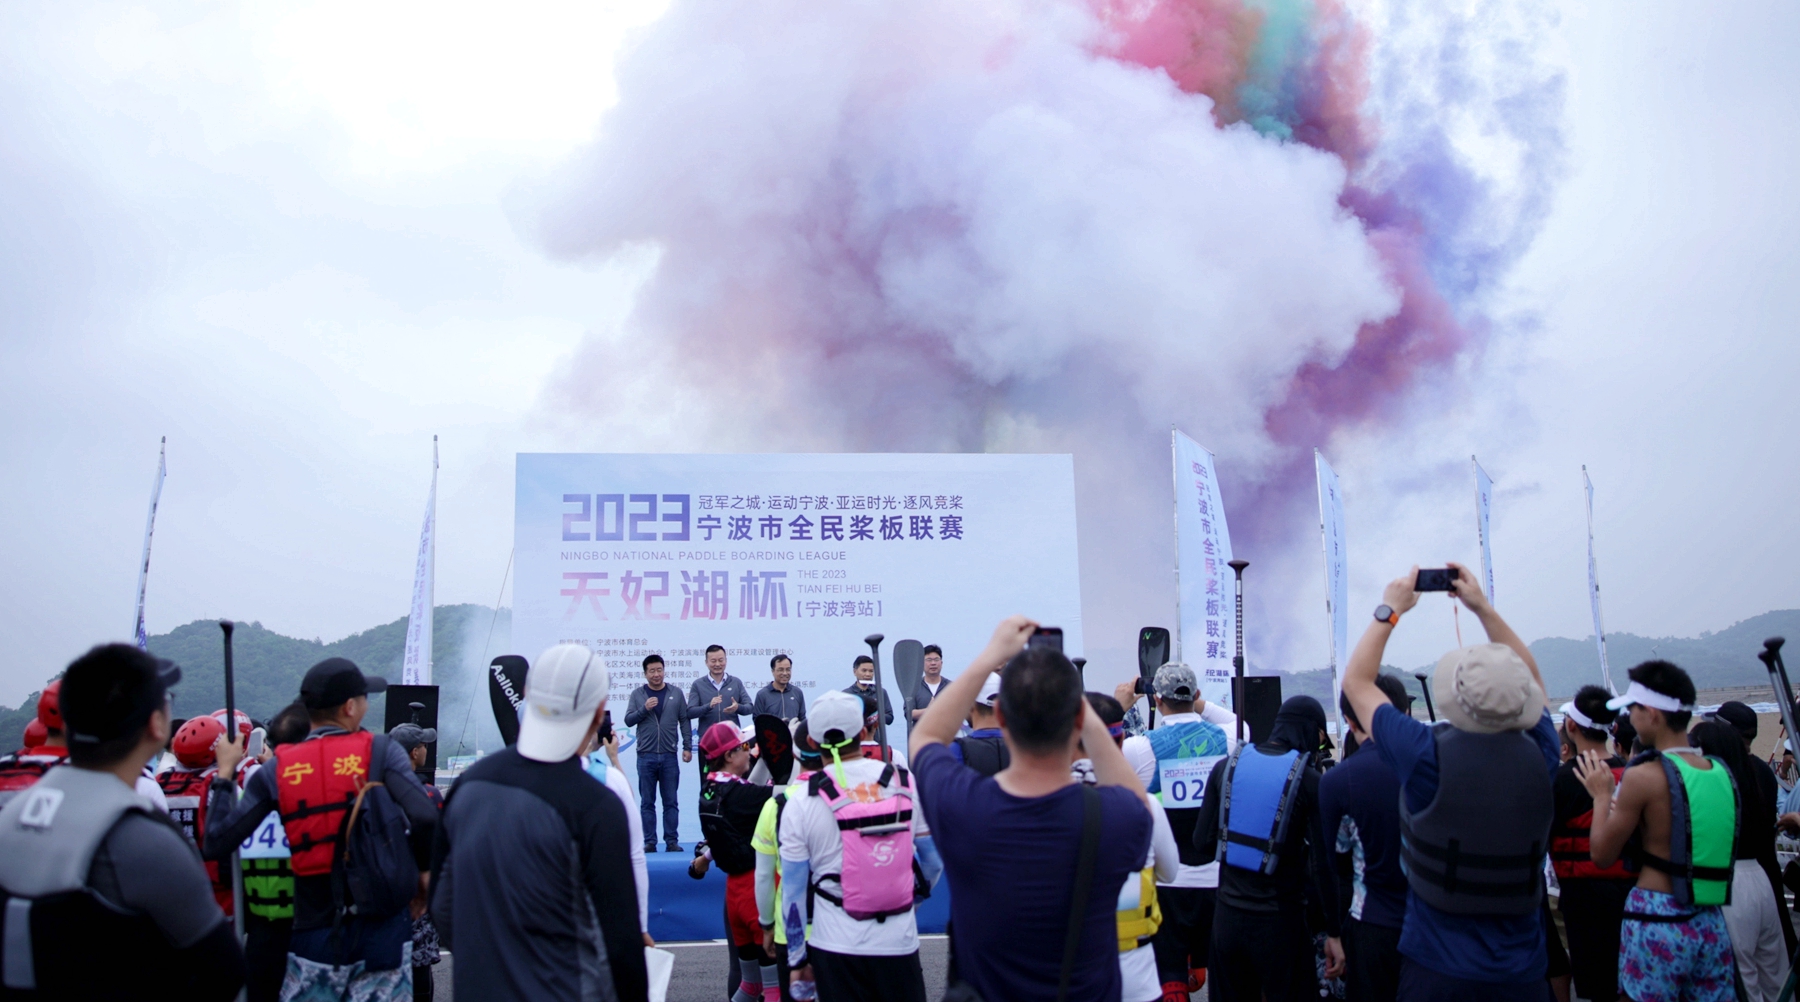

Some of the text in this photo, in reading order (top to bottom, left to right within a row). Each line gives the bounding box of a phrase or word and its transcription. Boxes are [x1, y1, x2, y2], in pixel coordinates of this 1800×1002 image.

[698, 495, 964, 510] 冠军之城·运动宁波·亚运时光·逐风竞桨
[562, 494, 690, 541] 2023
[697, 514, 964, 541] 宁波市全民桨板联赛
[561, 551, 846, 560] NINGBO NATIONAL PADDLE BOARDING LEAGUE
[797, 570, 846, 579] THE 2023
[1195, 479, 1219, 659] 宁波市全民桨板联赛
[560, 570, 788, 620] 天妃湖杯
[797, 584, 882, 593] TIAN FEI HU BEI
[797, 600, 883, 618] 【宁波湾站】
[597, 638, 648, 646] 宁波市体育总会
[282, 753, 365, 785] 宁波
[1172, 780, 1204, 801] 02
